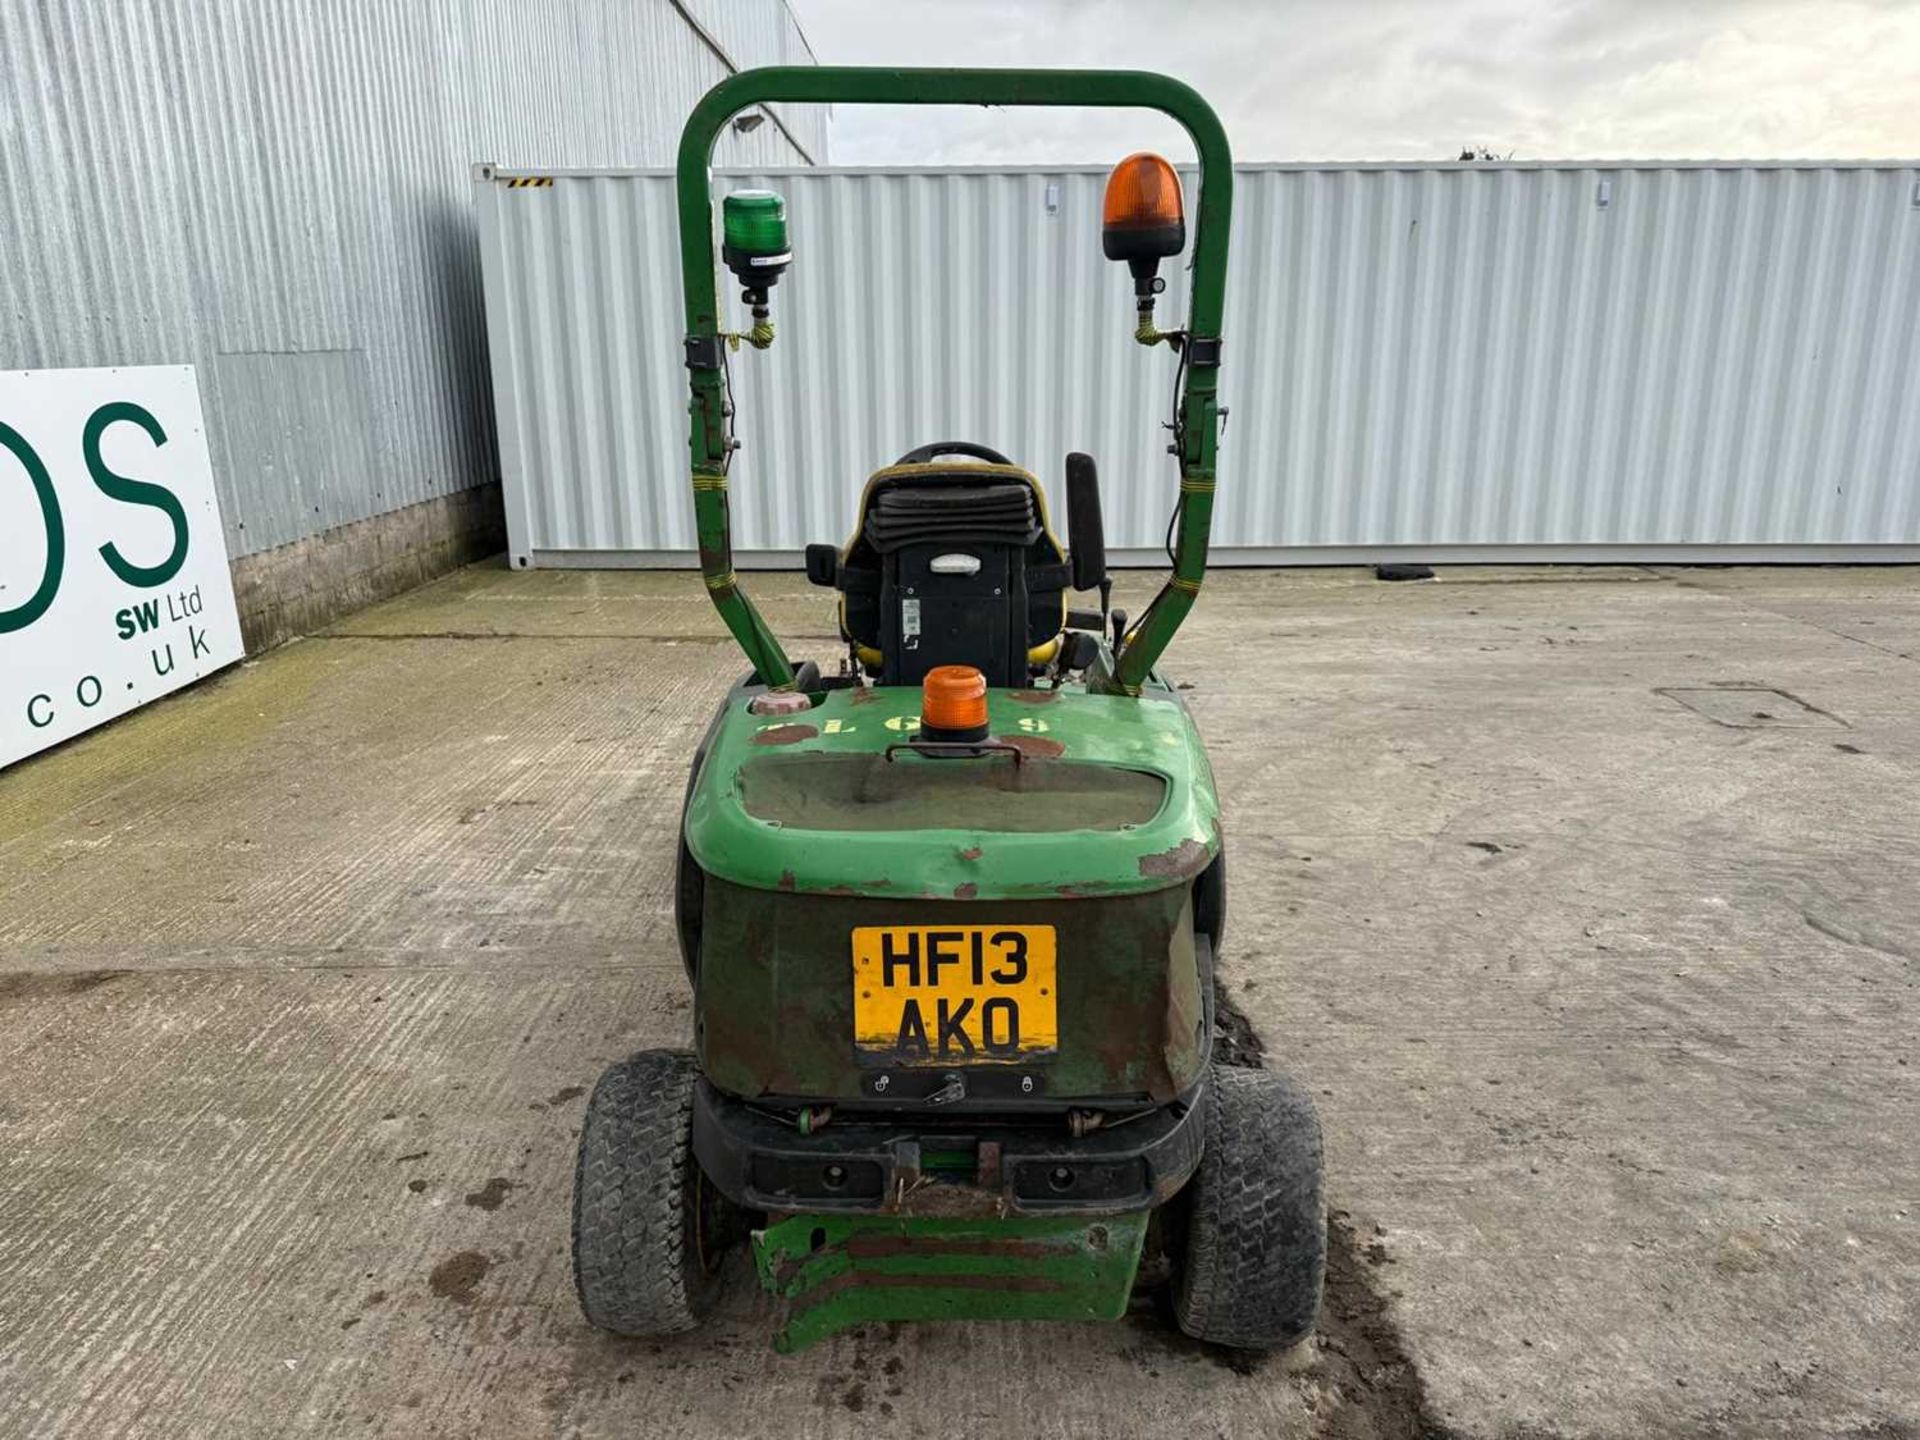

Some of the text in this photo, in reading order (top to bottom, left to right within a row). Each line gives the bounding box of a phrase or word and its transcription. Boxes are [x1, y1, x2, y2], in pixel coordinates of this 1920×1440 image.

[116, 584, 203, 640] SW Ltd
[881, 931, 1028, 987] HF13
[898, 997, 1019, 1058] AKO
